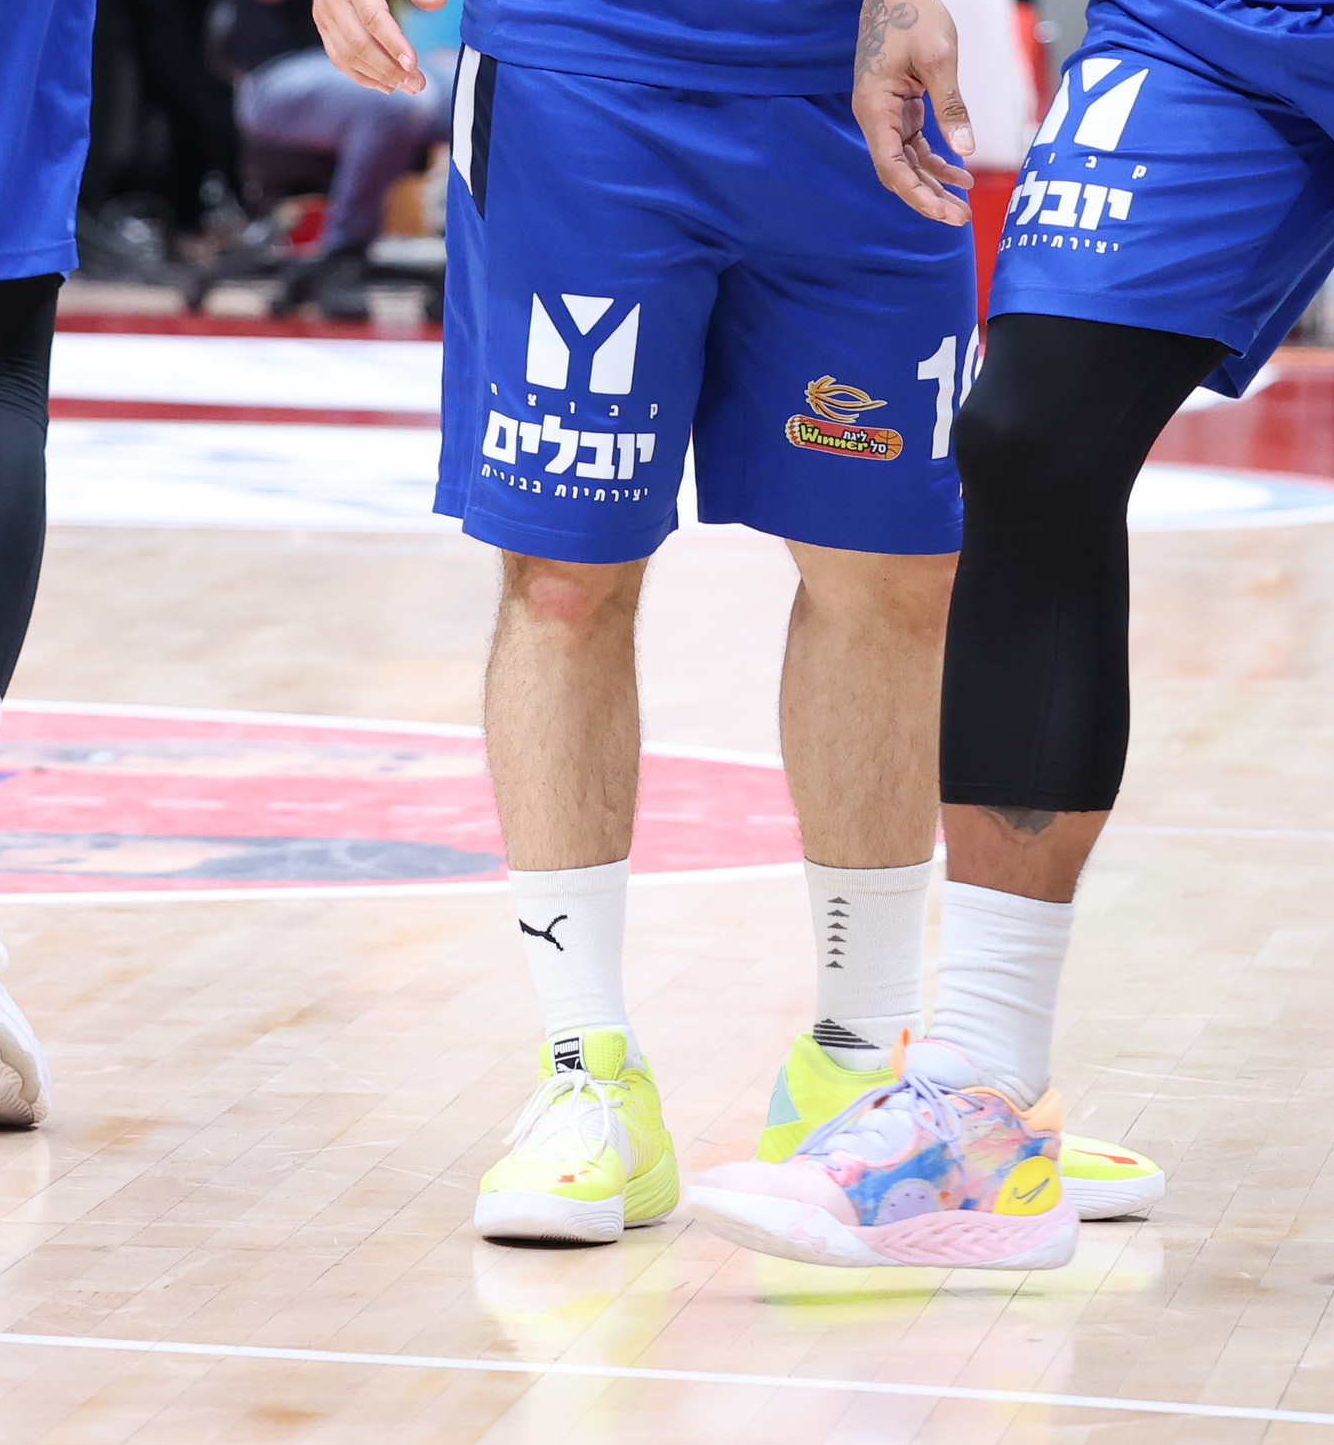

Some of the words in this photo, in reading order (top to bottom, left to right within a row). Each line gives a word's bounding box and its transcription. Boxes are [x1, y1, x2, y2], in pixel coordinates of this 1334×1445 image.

[1000, 170, 1134, 233] יובלי
[482, 409, 656, 480] יובלים
[799, 424, 869, 452] Winner
[480, 463, 542, 494] בבנייה
[554, 484, 649, 502] יצירתיות
[554, 1040, 579, 1056] PUMA
